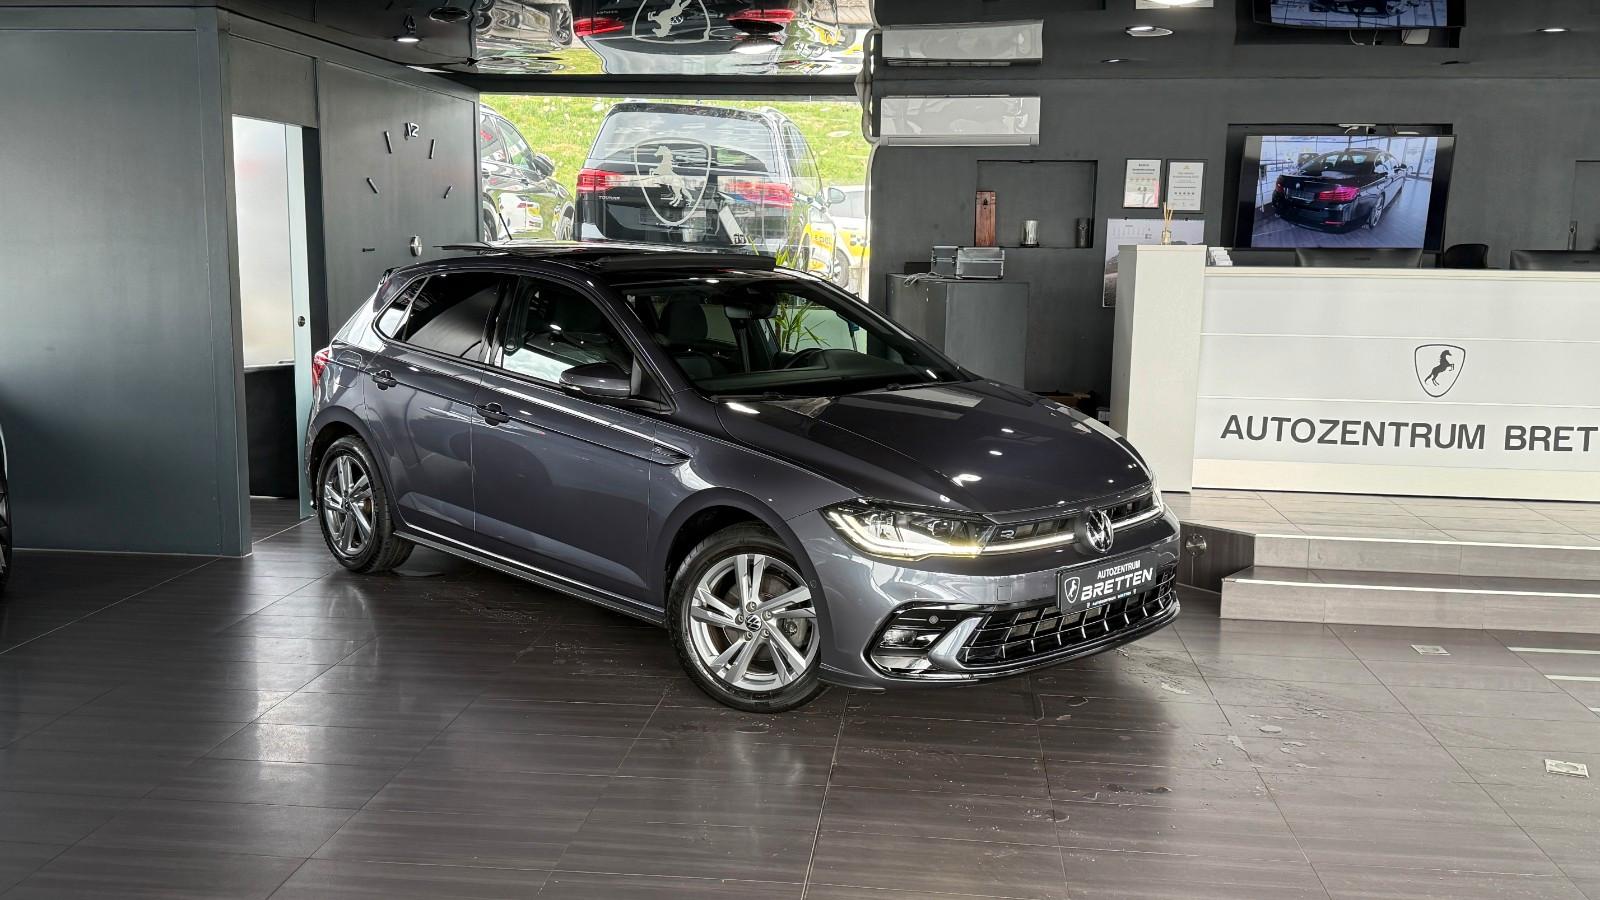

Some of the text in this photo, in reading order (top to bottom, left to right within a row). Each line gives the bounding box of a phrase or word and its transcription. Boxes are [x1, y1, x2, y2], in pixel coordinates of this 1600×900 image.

[405, 122, 419, 137] 12
[1220, 414, 1599, 452] AUTOZENTRUM BRET
[1097, 560, 1141, 579] AUTOZENTRUM
[1081, 568, 1153, 601] BRETTEN
